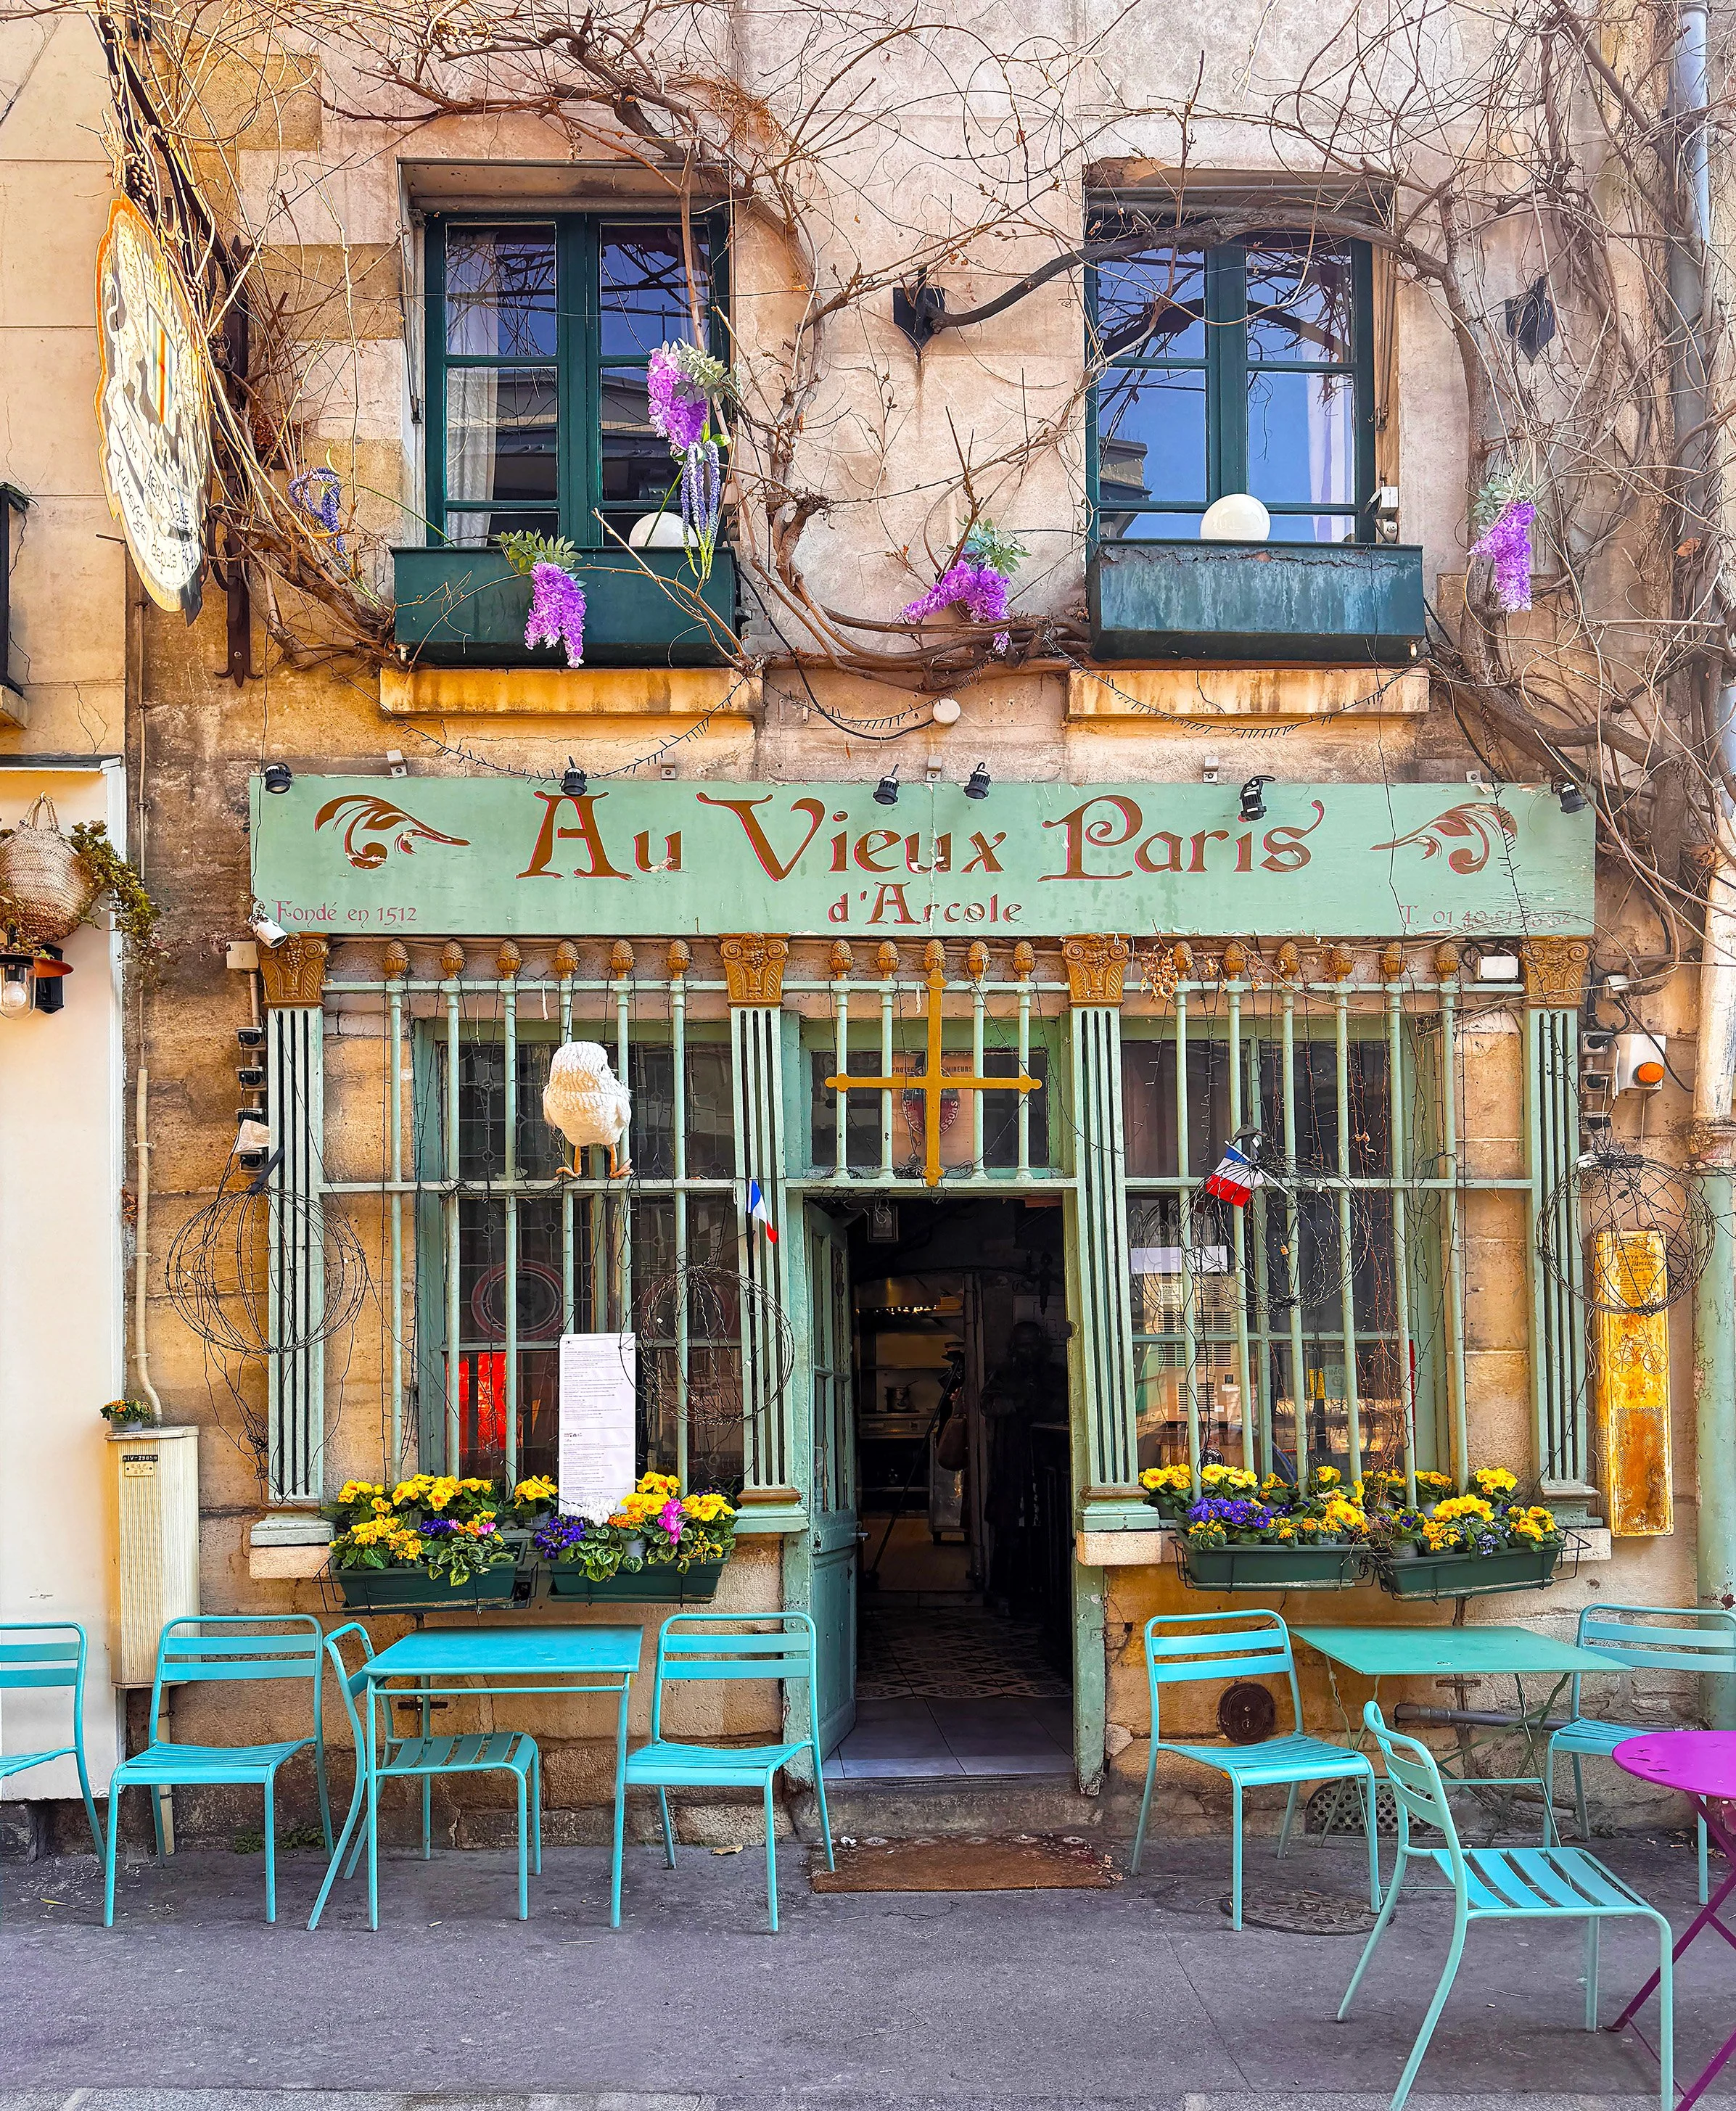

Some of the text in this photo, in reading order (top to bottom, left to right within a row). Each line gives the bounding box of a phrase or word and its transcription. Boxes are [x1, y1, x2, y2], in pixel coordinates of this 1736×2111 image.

[114, 448, 147, 540] Auberge
[516, 791, 1325, 882] Au Vieux Paris
[271, 899, 418, 929] Fondé en 1512
[828, 881, 1024, 926] d'Arcole
[939, 1100, 958, 1133] ISSONS
